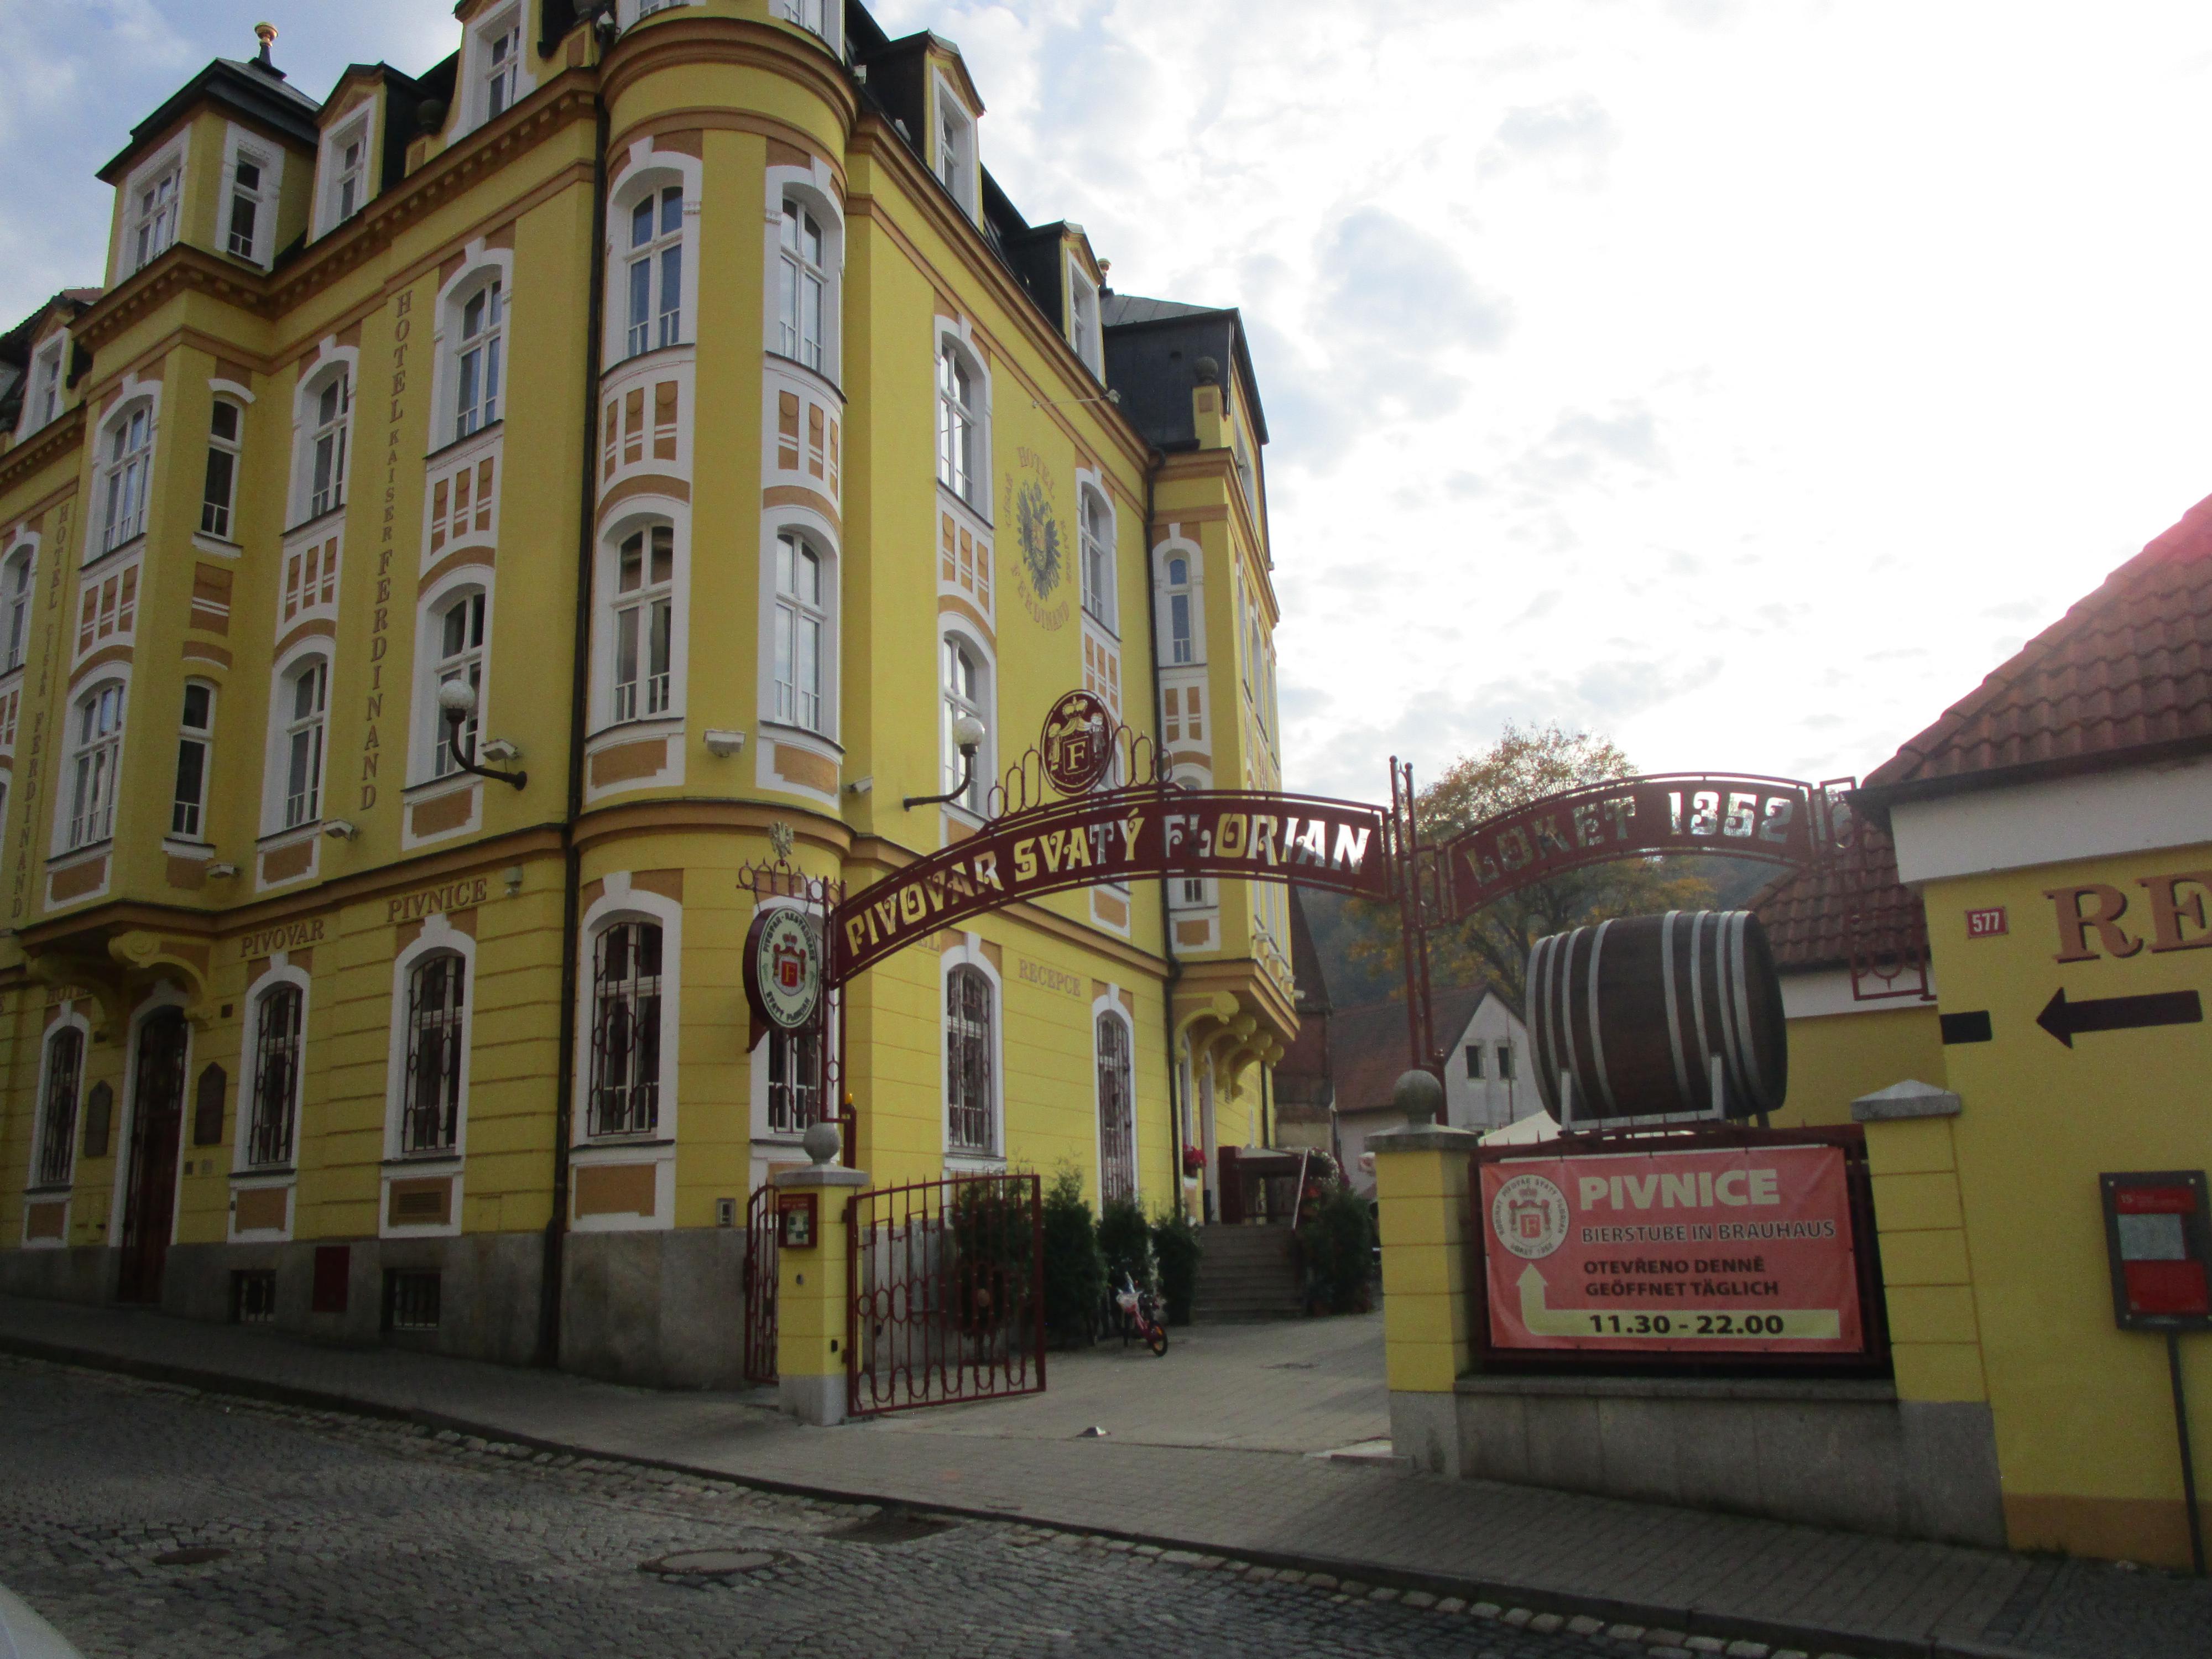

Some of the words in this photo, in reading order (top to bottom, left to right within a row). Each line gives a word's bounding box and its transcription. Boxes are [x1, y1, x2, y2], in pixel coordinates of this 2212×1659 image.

[389, 289, 413, 424] HOTEL
[382, 429, 400, 543] KAISER
[359, 549, 393, 811] FERDINAND
[1067, 742, 1086, 770] F
[1464, 795, 1636, 886] LOKET
[1668, 791, 1793, 844] 1352
[387, 878, 488, 922] PIVNICE
[844, 851, 1004, 957] PIVOVAR
[1014, 807, 1145, 881] SVATÝ
[1165, 812, 1371, 874] FLORIAN
[241, 918, 325, 958] PIVOVAR
[1973, 911, 2000, 933] 577
[785, 964, 796, 982] F
[1018, 958, 1081, 997] RECEPCE
[1579, 1169, 1780, 1210] PIVNICE
[1526, 1218, 1537, 1234] F
[1582, 1225, 1687, 1243] BIERSTUBE
[1692, 1224, 1712, 1241] IN
[1718, 1220, 1835, 1241] BRAUHAUS
[1584, 1258, 1689, 1274] OTEVŘENO
[1694, 1256, 1765, 1272] DENNĚ
[1585, 1279, 1686, 1296] GEÖFFNET
[1690, 1279, 1778, 1296] TÄGLICH
[1590, 1315, 1671, 1333] 11.30
[1697, 1315, 1783, 1334] 22.00
